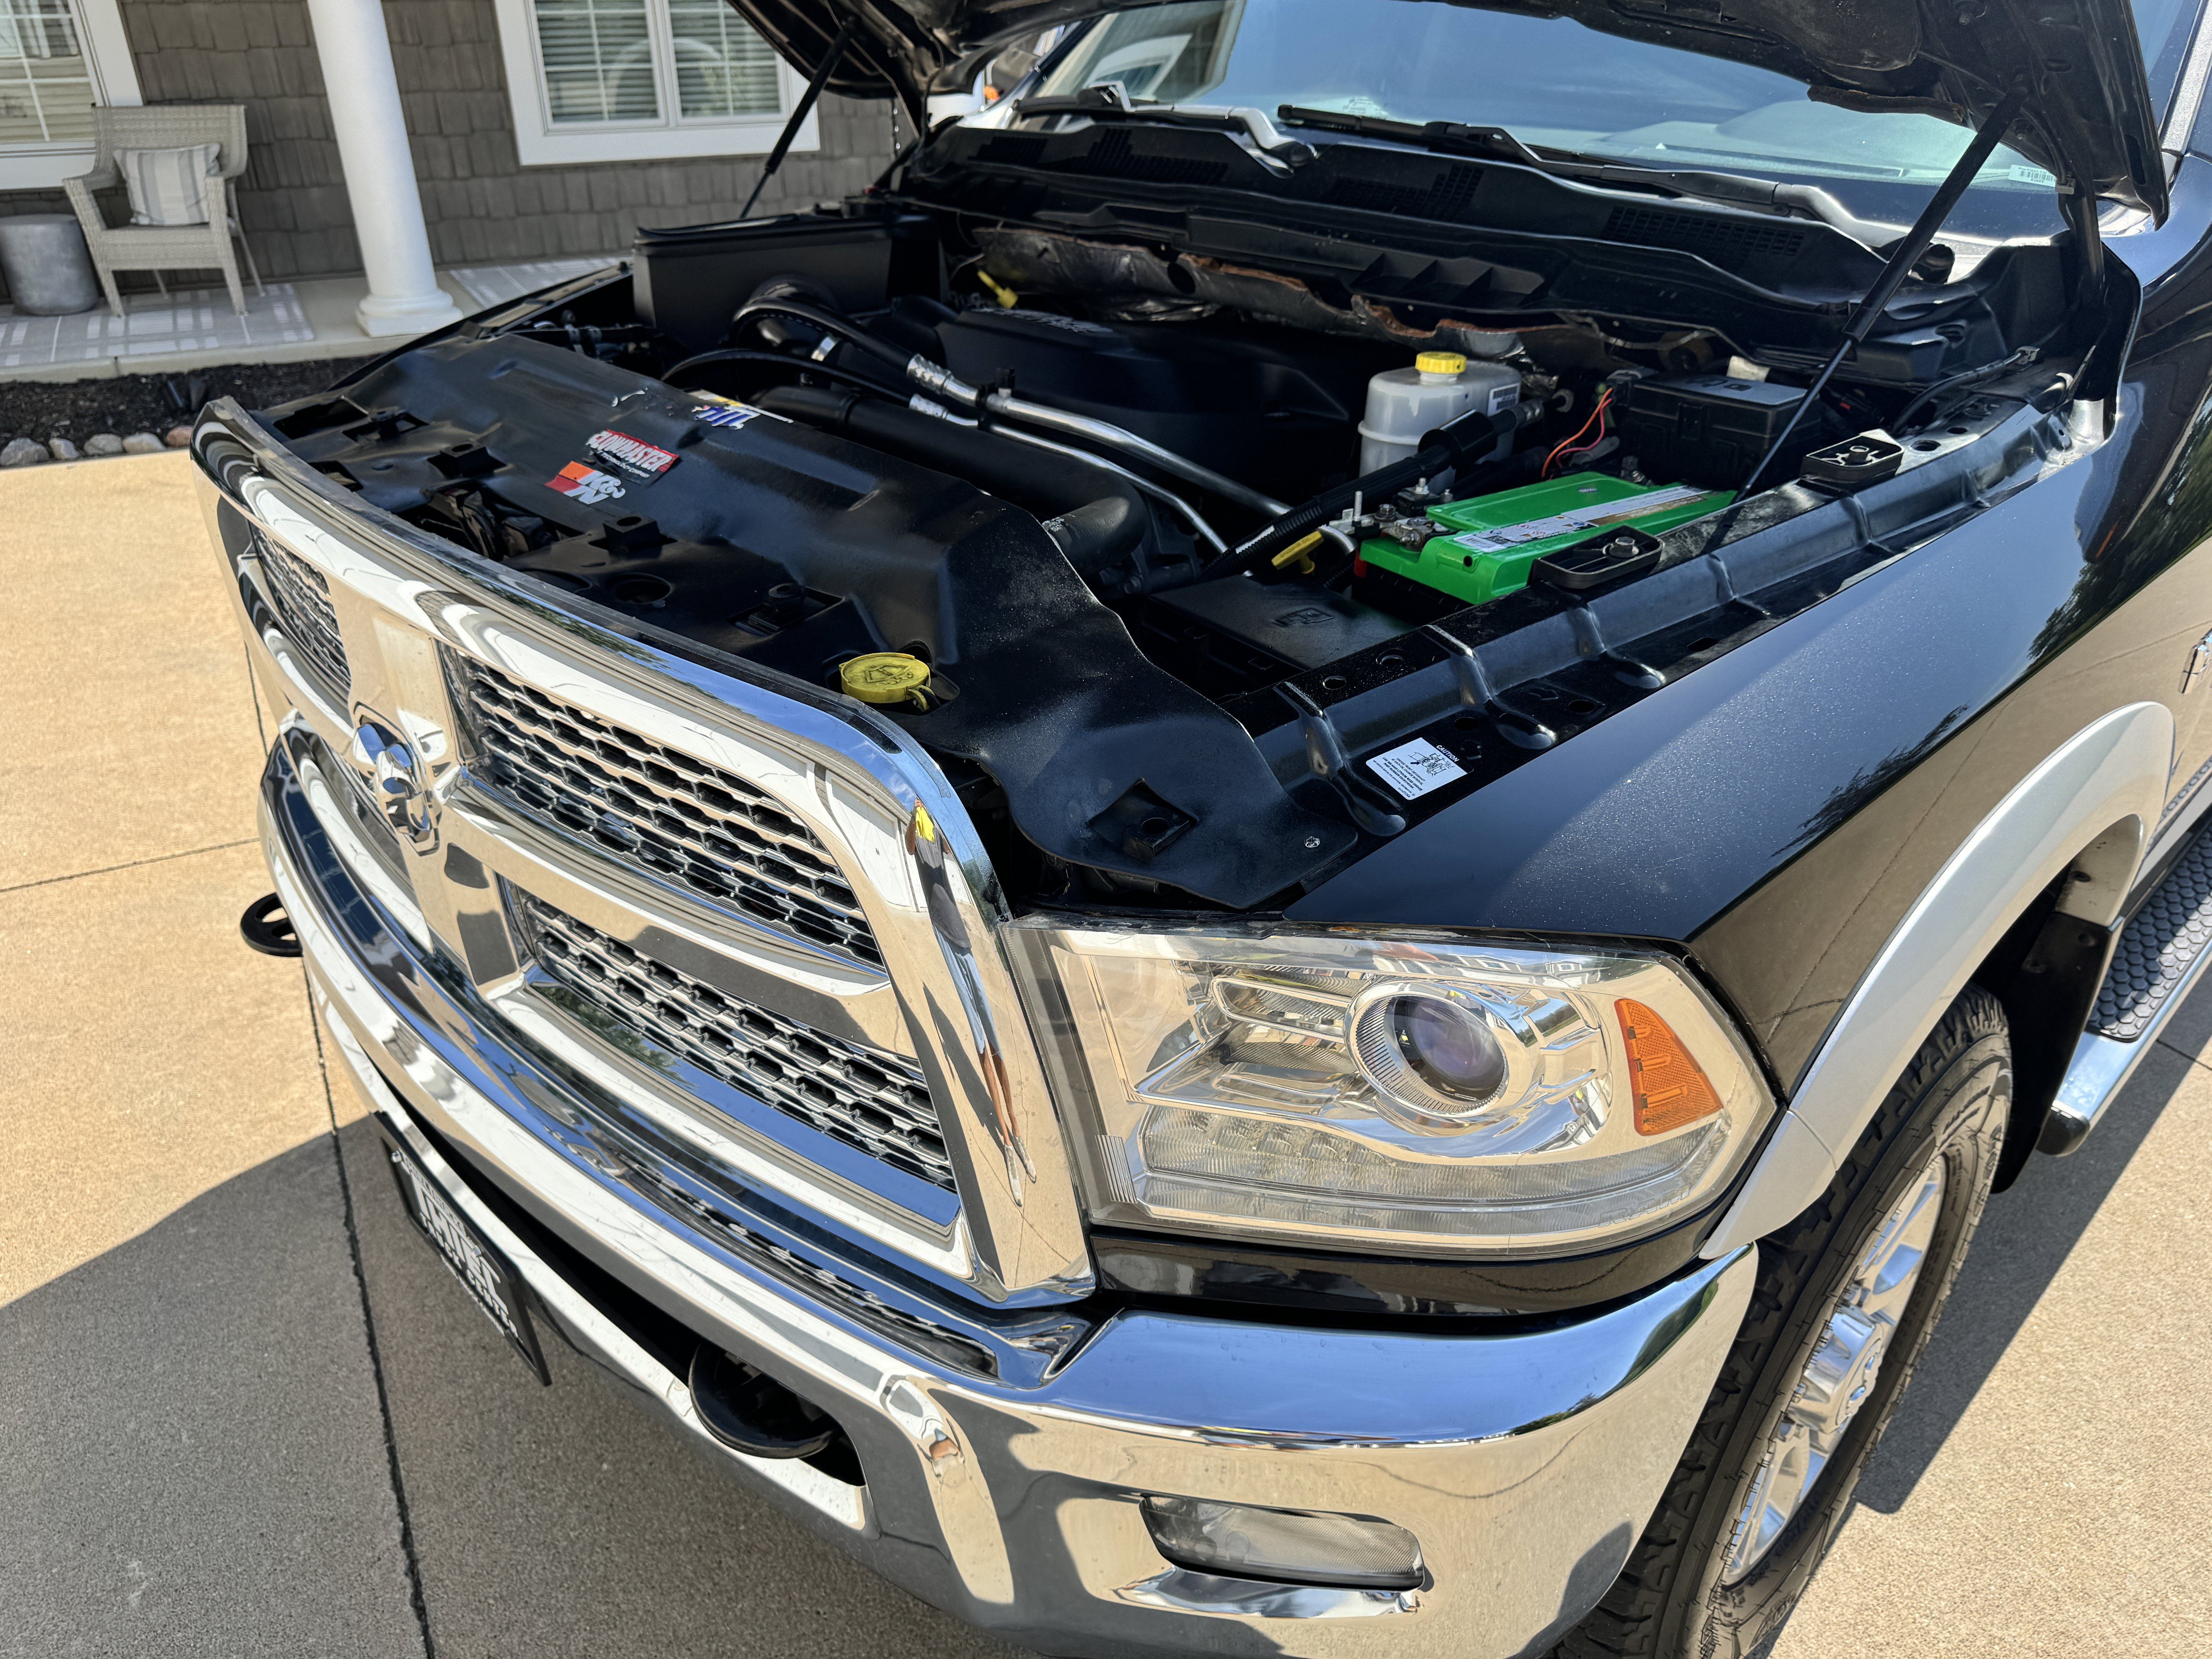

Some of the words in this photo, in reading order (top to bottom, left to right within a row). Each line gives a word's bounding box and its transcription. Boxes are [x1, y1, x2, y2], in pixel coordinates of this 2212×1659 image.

[586, 431, 673, 472] FLOWMASTER
[564, 470, 626, 505] K&N
[1436, 744, 1460, 762] CAUTION
[420, 1212, 462, 1270] TRUCK
[466, 1269, 518, 1337] CENTER
